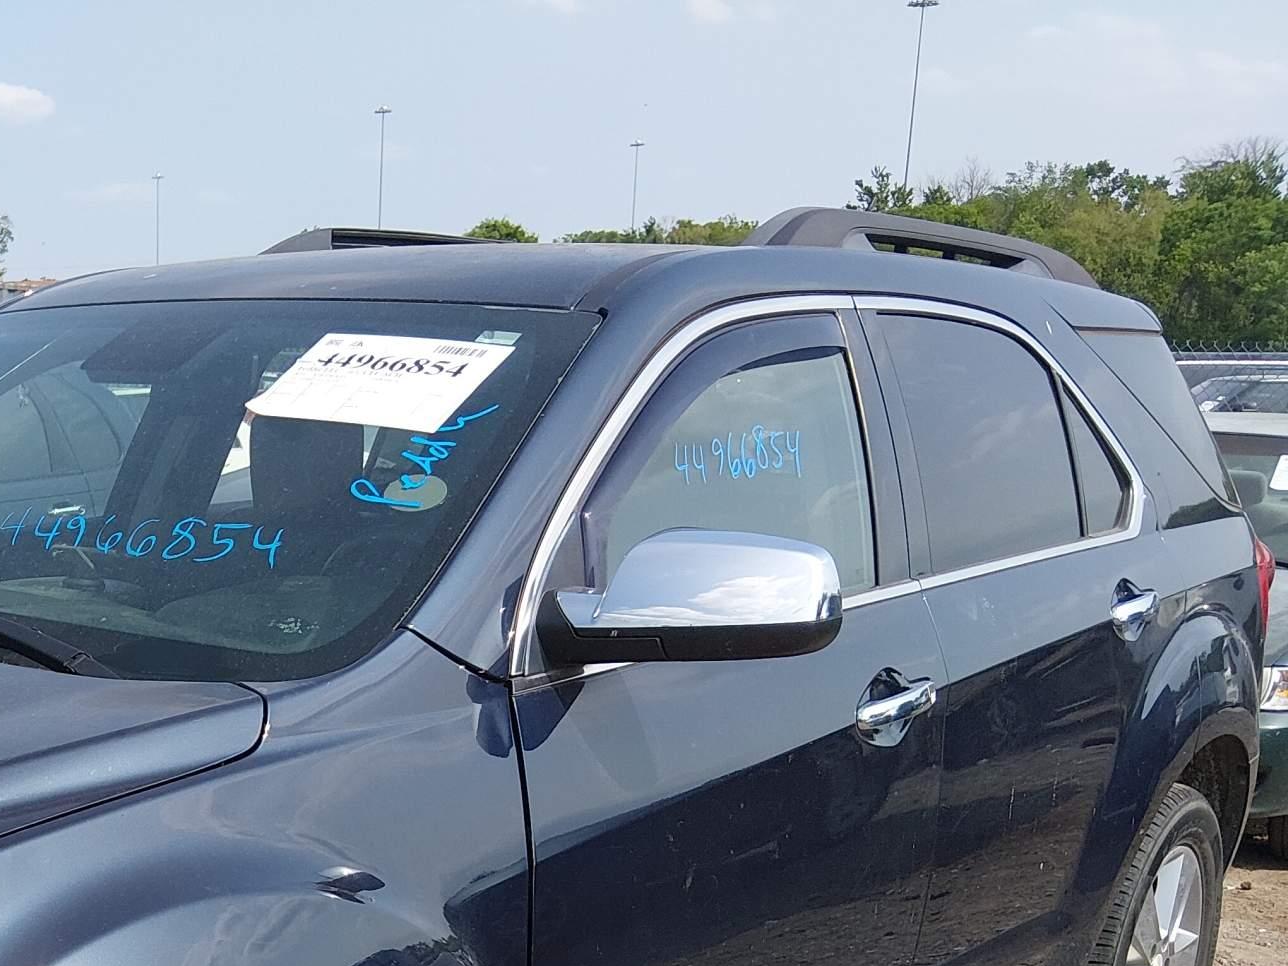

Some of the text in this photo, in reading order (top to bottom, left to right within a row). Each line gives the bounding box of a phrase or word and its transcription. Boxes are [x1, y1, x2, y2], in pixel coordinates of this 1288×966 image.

[317, 352, 469, 378] 44966854
[675, 425, 801, 485] 44966854
[0, 505, 285, 569] 44966854
